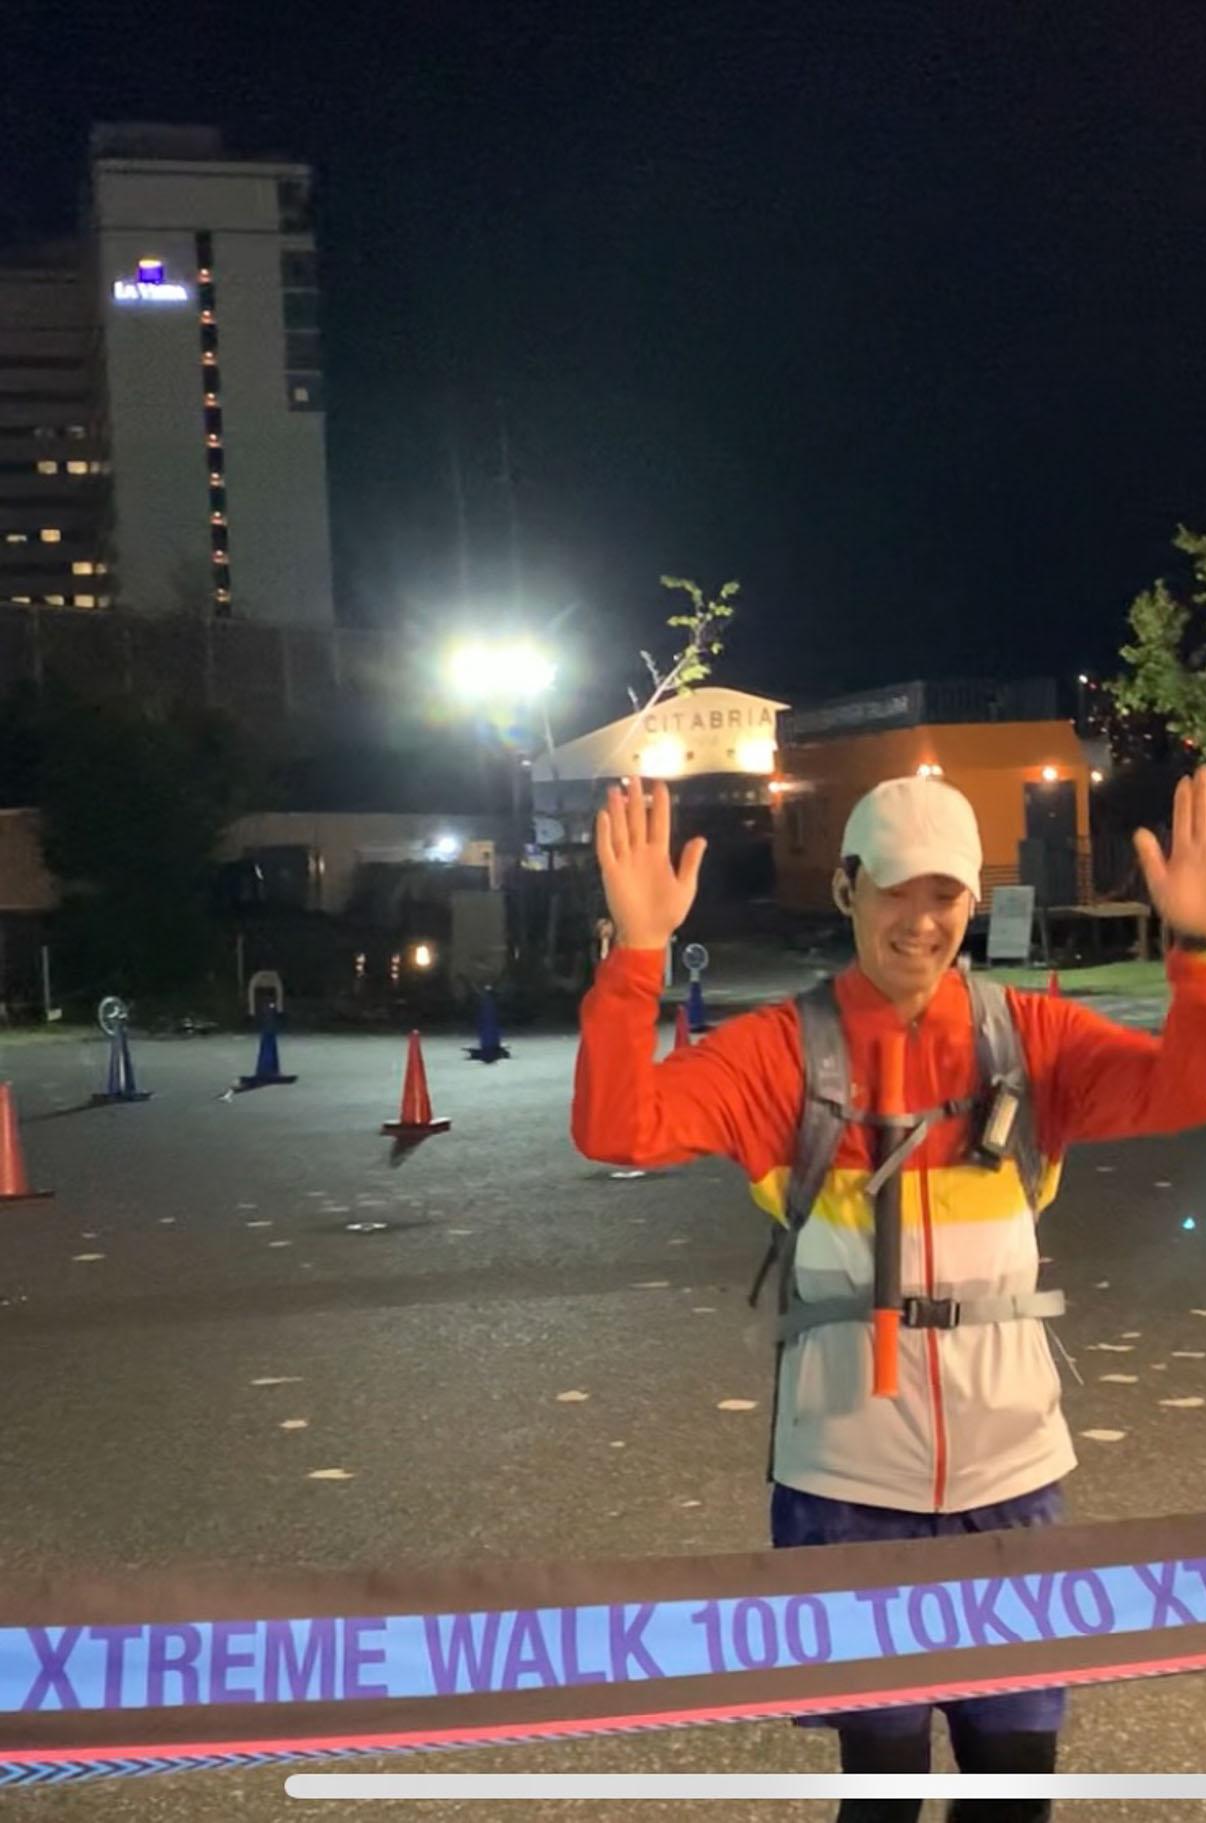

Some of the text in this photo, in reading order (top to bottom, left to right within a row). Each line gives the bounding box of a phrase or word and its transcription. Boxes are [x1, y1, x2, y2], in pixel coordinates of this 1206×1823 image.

[643, 707, 774, 734] CITABRIA
[20, 1615, 389, 1712] XTREME
[424, 1603, 667, 1694] WALK
[692, 1595, 832, 1675] 100
[856, 1569, 1116, 1660] TOKYO
